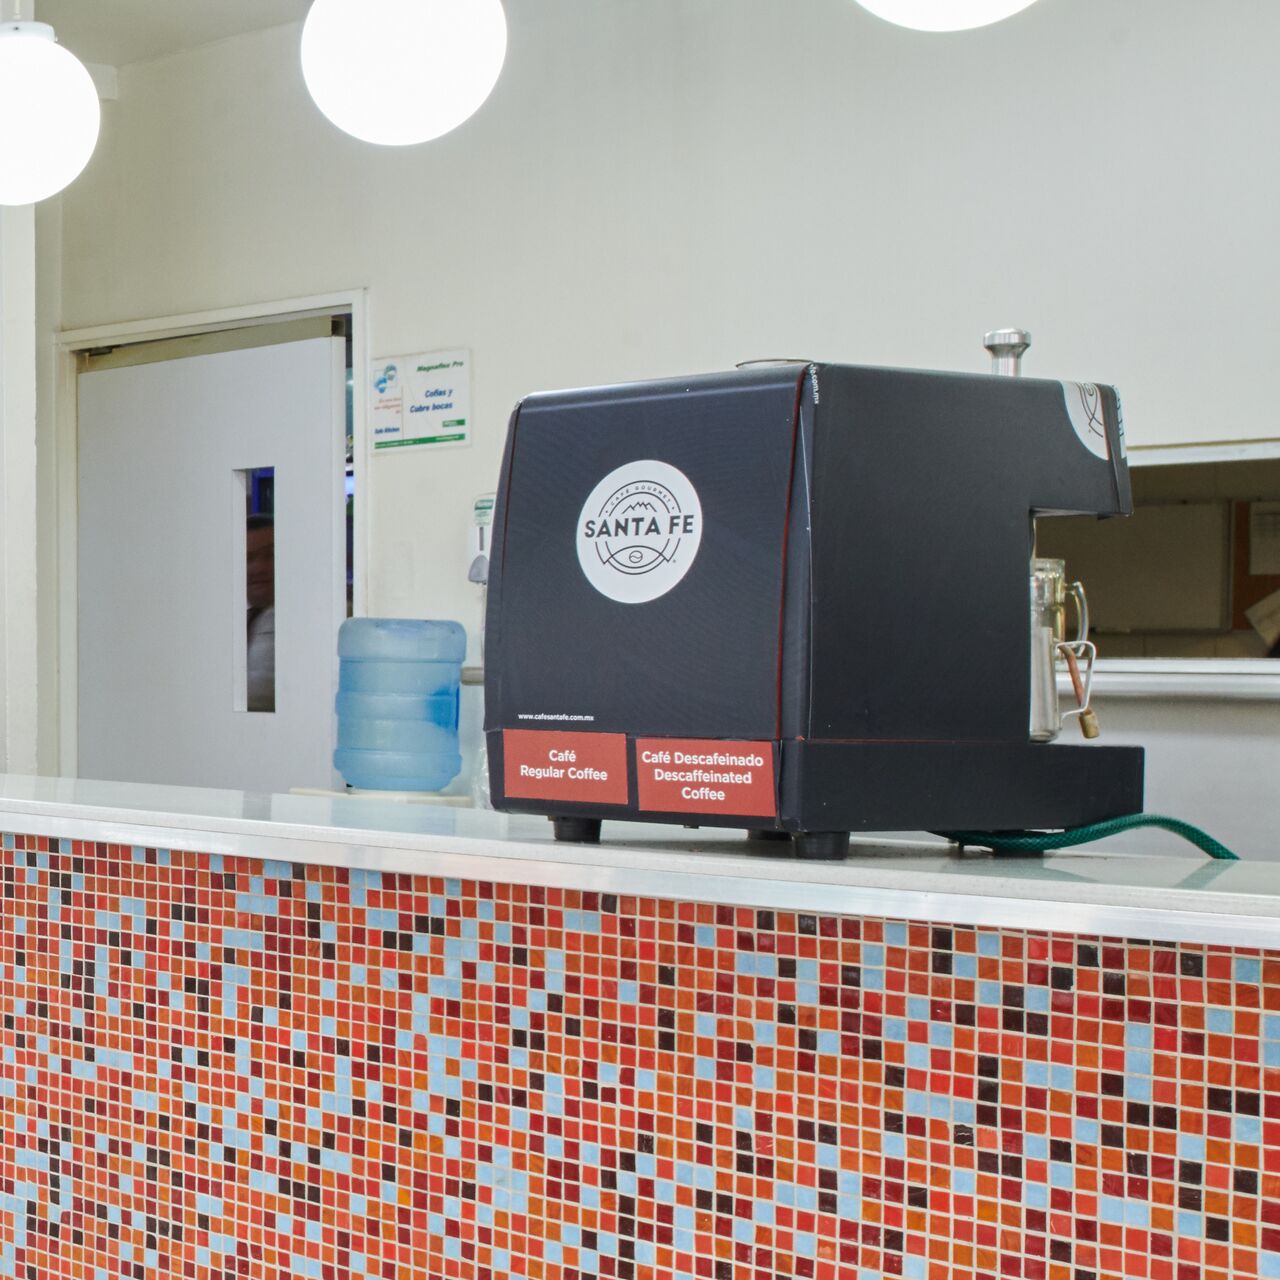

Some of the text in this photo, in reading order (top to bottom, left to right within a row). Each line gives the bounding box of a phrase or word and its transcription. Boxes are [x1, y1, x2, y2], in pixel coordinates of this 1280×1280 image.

[409, 404, 430, 413] Cubre
[431, 402, 453, 411] bocas
[610, 484, 671, 506] CAFÉ GOURMET
[584, 514, 694, 538] SANTA FE
[517, 713, 594, 722] www.cafesantafe.com.mx
[548, 749, 577, 762] Café
[642, 751, 764, 767] Café Descafeinado
[520, 765, 608, 781] Regular Coffee
[654, 768, 752, 784] Descaffeinated
[681, 787, 725, 801] Coffee
